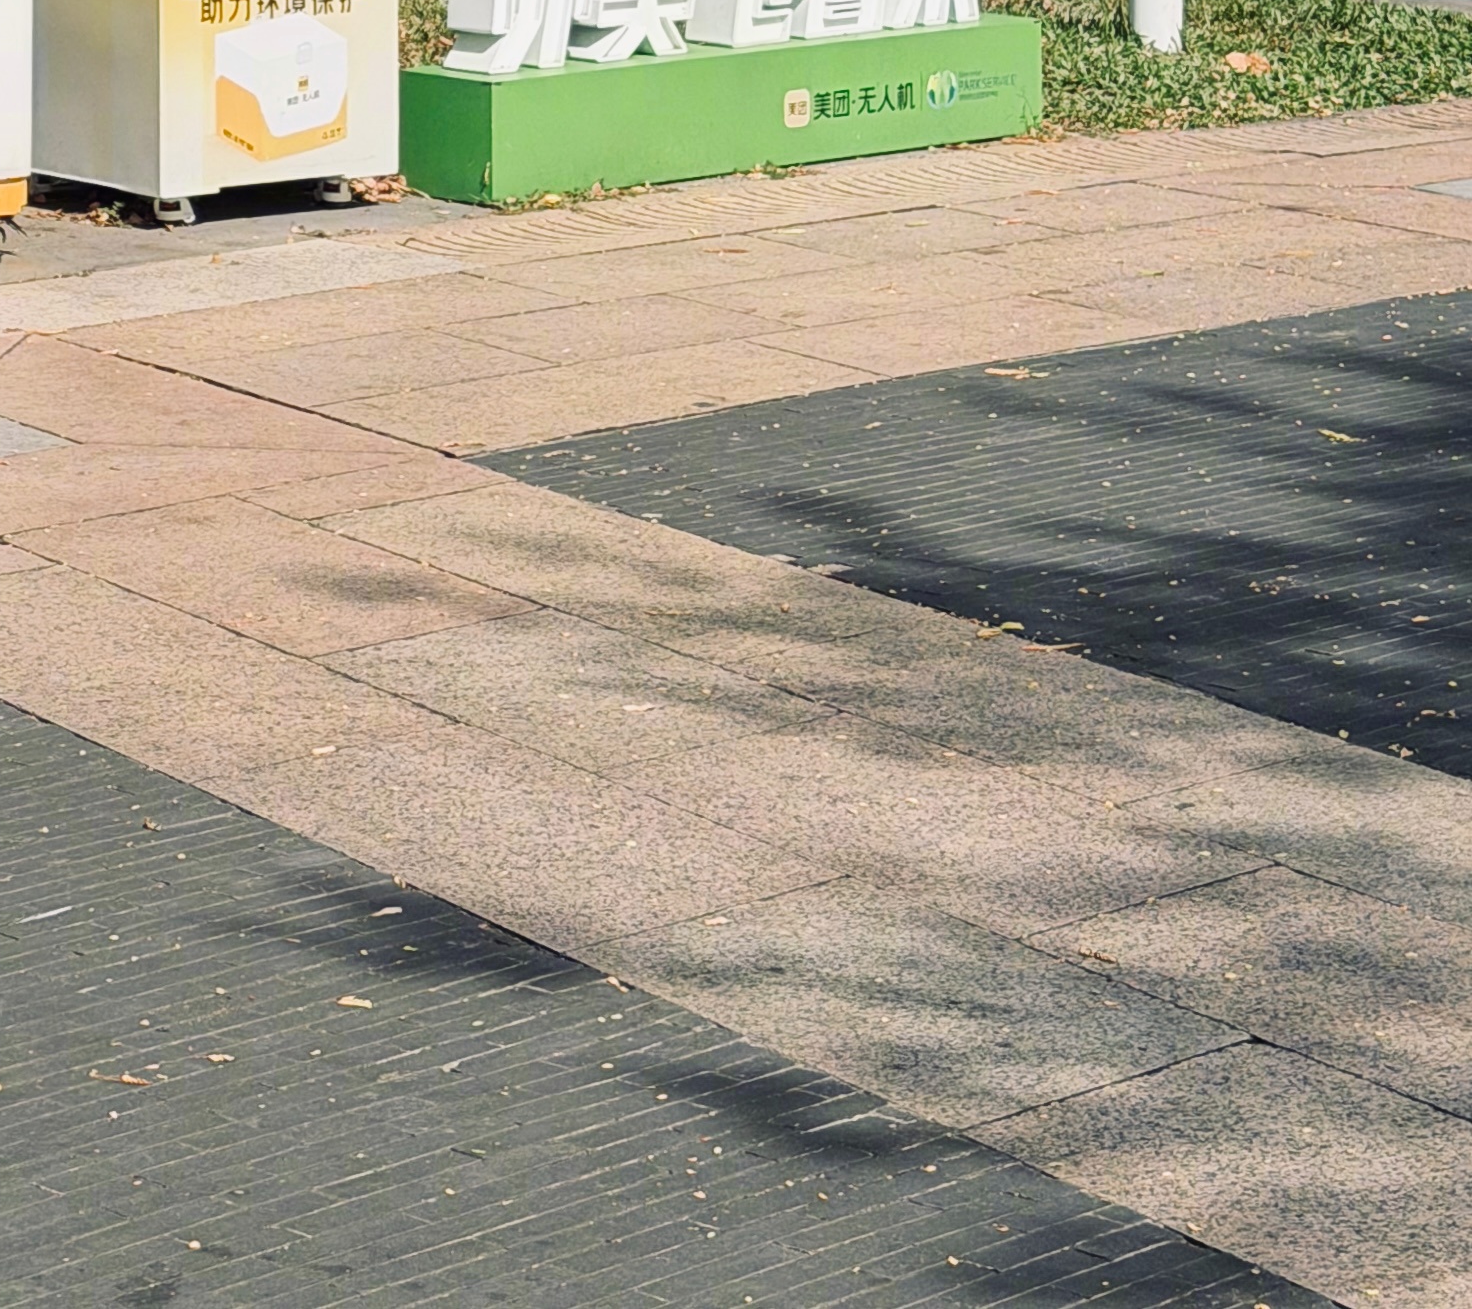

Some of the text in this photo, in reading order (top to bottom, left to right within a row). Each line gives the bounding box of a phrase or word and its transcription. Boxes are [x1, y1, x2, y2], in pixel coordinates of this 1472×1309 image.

[788, 100, 807, 116] 美团
[813, 82, 916, 120] 美团·无人机
